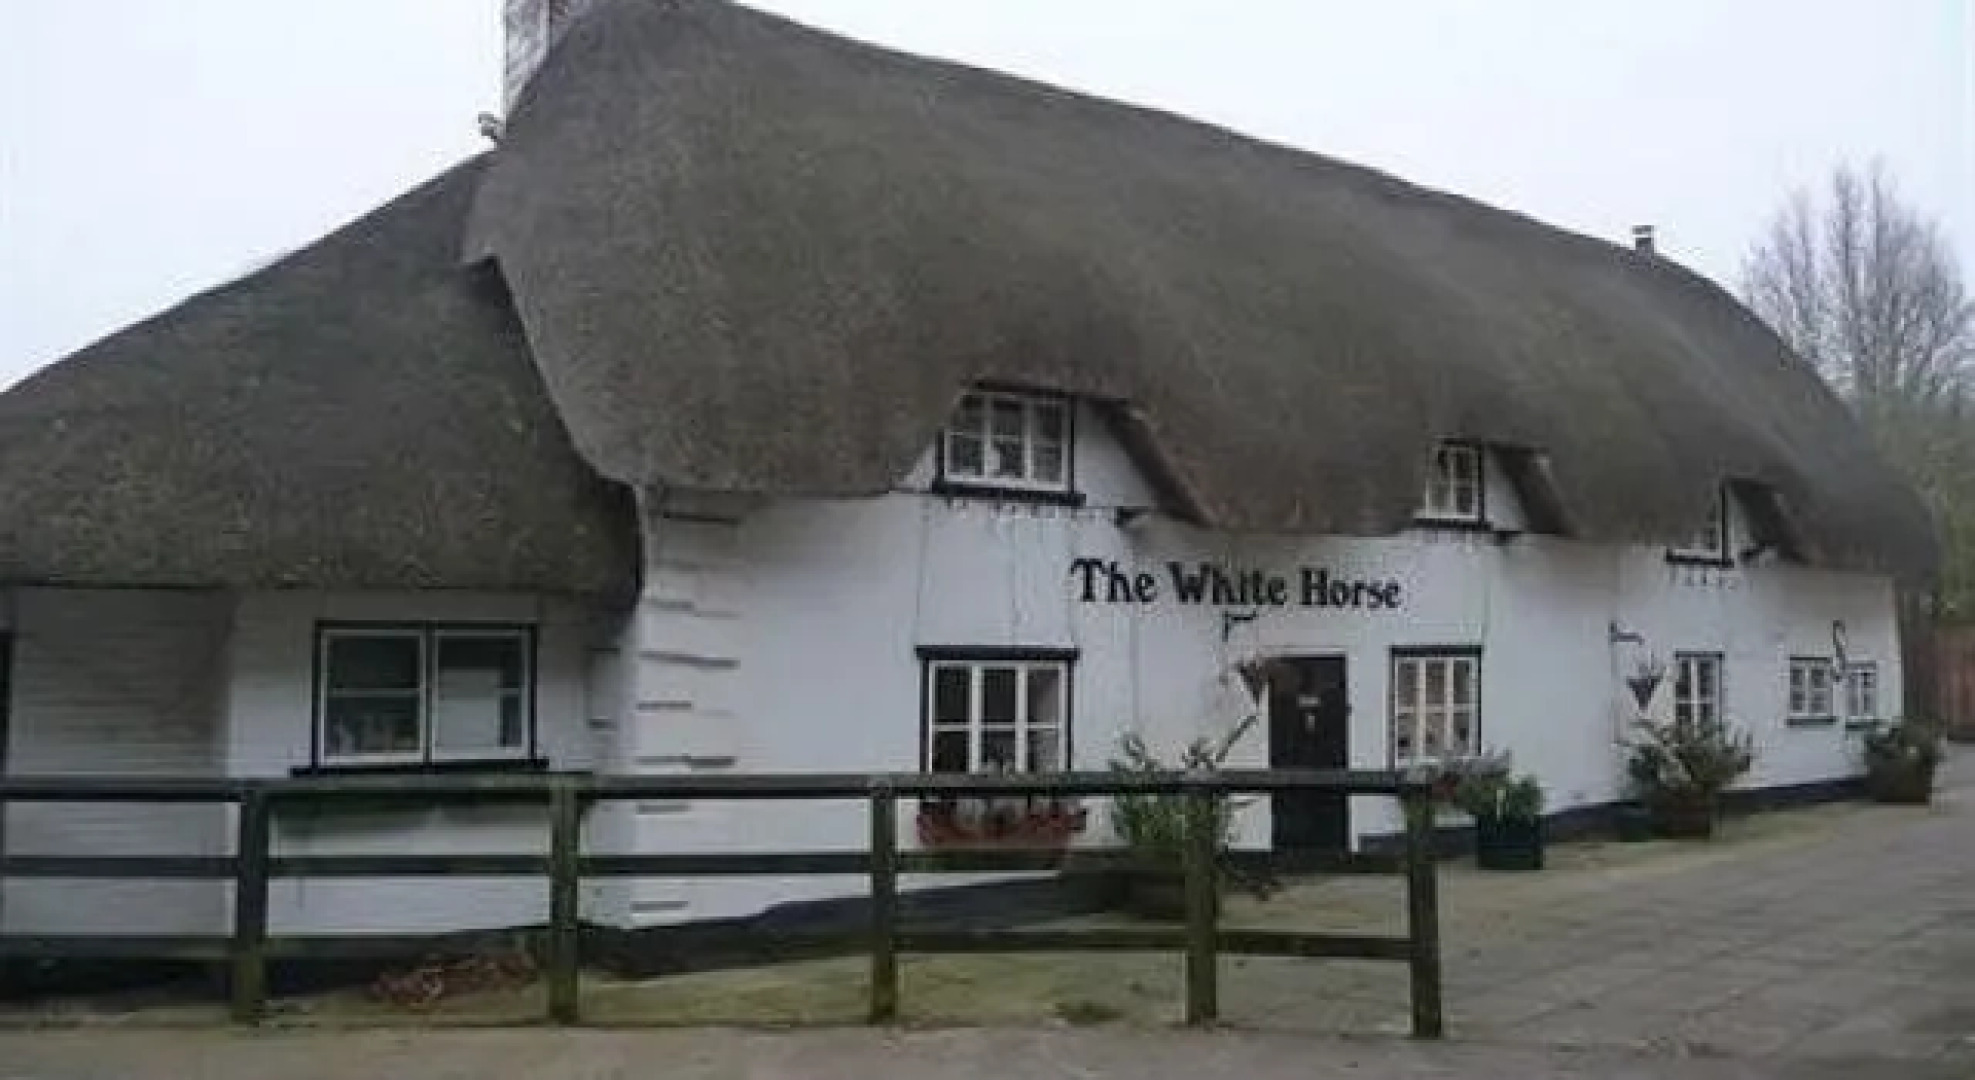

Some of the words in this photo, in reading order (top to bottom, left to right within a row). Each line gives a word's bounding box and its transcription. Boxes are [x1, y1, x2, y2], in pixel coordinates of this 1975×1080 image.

[1069, 557, 1157, 603] The
[1166, 561, 1288, 606] White
[1300, 567, 1402, 609] Horse
